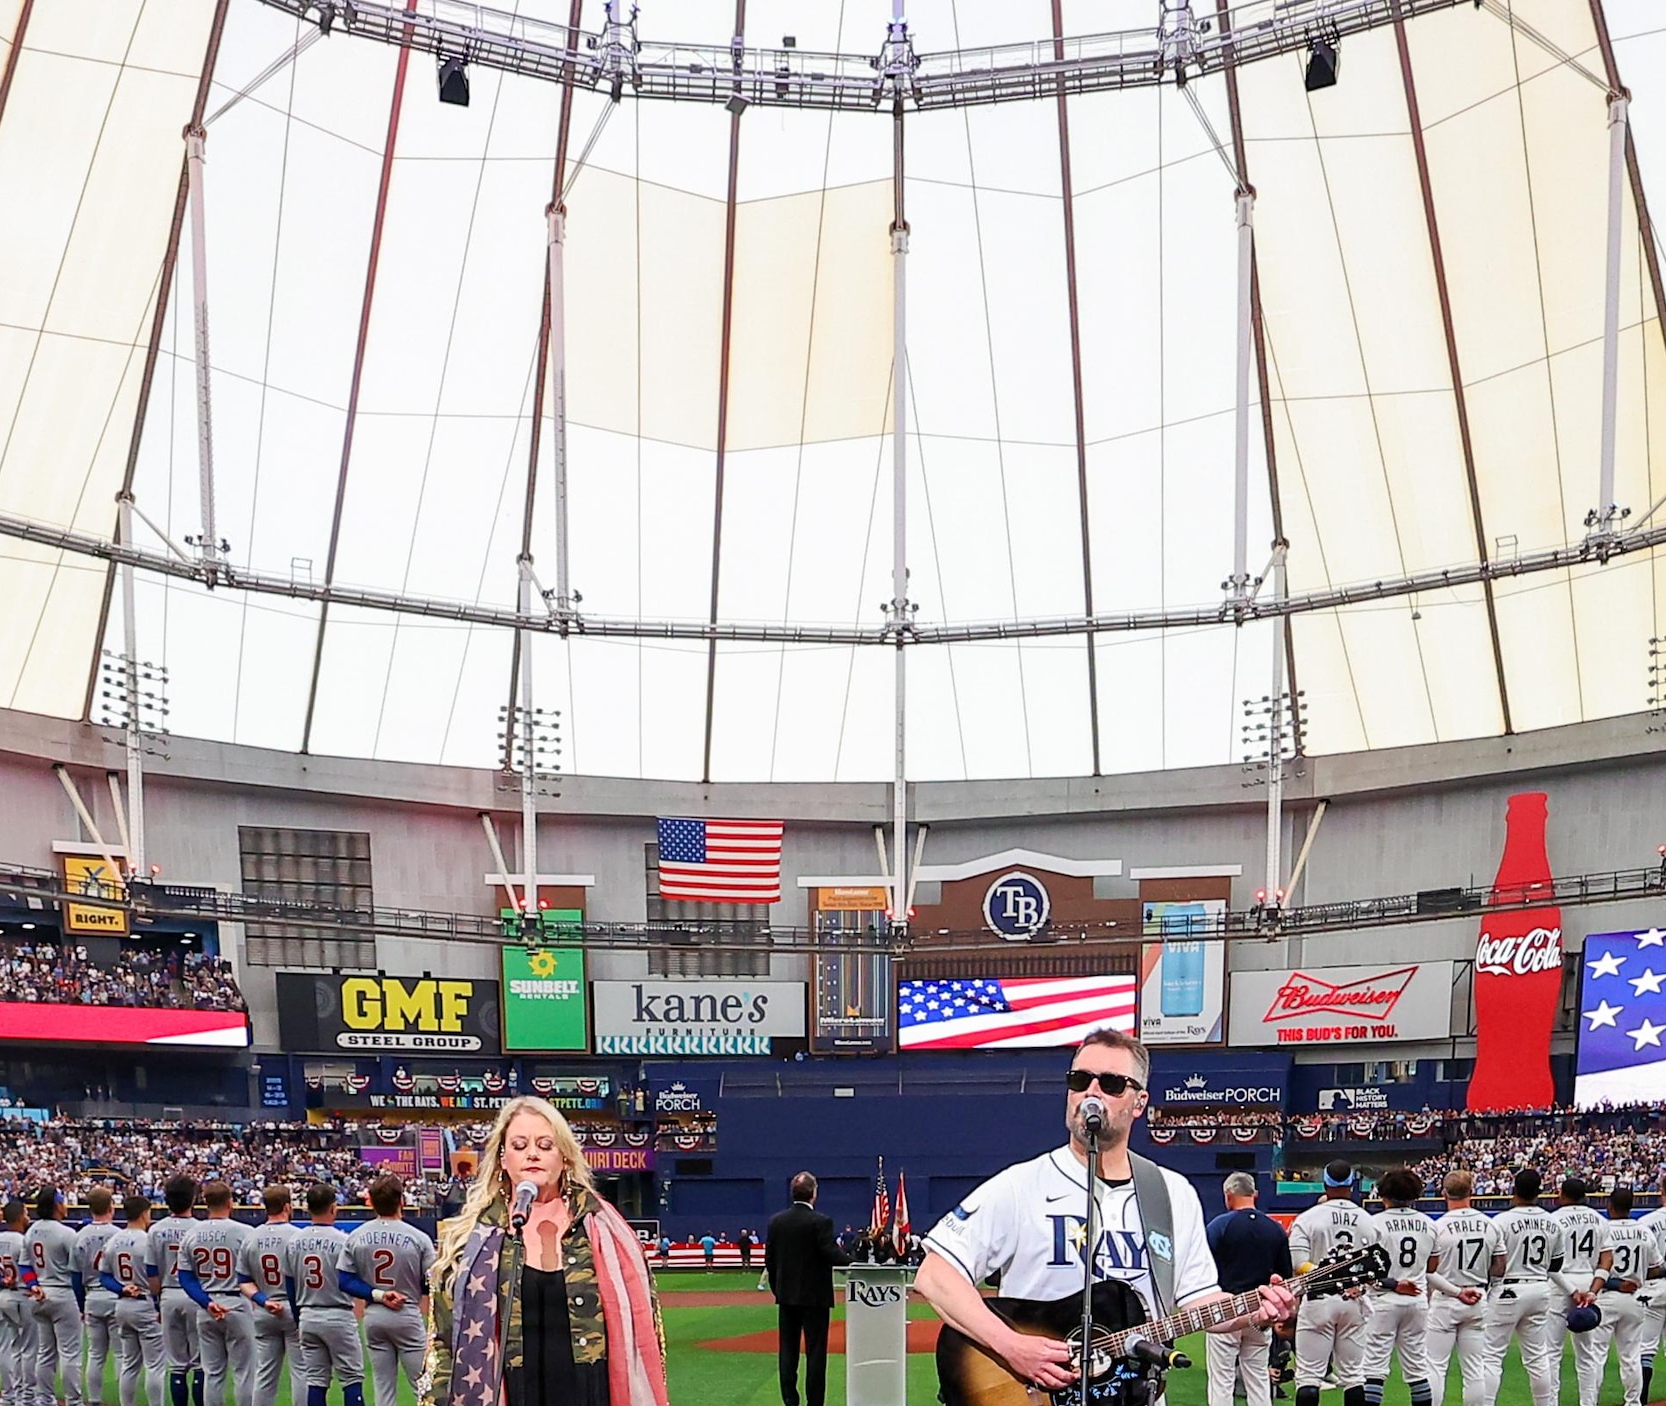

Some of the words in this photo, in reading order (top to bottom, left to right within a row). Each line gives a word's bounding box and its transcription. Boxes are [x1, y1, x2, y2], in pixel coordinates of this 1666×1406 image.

[75, 912, 119, 926] RIGHT.
[1475, 927, 1562, 976] Coca-Cola
[341, 977, 473, 1033] GMF
[519, 992, 569, 1001] RENTALS
[631, 983, 769, 1024] kane's
[1278, 985, 1402, 1011] Budweiser
[347, 1035, 406, 1047] STEEL
[412, 1036, 471, 1048] GROUP
[645, 1028, 756, 1037] FURNITURE
[1277, 1028, 1303, 1042] THIS
[1306, 1027, 1342, 1042] BUD'S
[1344, 1026, 1368, 1040] FOR
[1371, 1024, 1399, 1039] YOU.
[1165, 1089, 1224, 1101] Budweiser
[1225, 1087, 1281, 1103] PORCH
[1356, 1087, 1381, 1096] BLACK
[1356, 1094, 1388, 1102] HISTORY
[370, 1095, 386, 1107] WE
[395, 1096, 413, 1108] THE
[440, 1096, 454, 1108] WE
[655, 1099, 701, 1111] PORCH
[1355, 1101, 1388, 1110] MATTERS
[614, 1152, 646, 1169] DECK
[1331, 1211, 1359, 1227] DIAZ
[1385, 1219, 1429, 1234] ARANDA
[1447, 1221, 1488, 1235] FRALEY
[1559, 1214, 1601, 1230] SIMPSON
[197, 1230, 227, 1243] BUSCH
[258, 1237, 282, 1249] HAPP
[359, 1231, 412, 1249] HOERNER
[1570, 1229, 1595, 1259] 14
[33, 1242, 45, 1269] 9
[1045, 1213, 1150, 1282] RAY
[1399, 1236, 1417, 1268] 8
[1457, 1238, 1485, 1271] 17
[1521, 1235, 1547, 1266] 13
[117, 1253, 133, 1281] 6
[193, 1247, 231, 1279] 29
[373, 1249, 395, 1286] 2
[1613, 1245, 1641, 1273] 31
[260, 1254, 282, 1286] 8
[304, 1254, 323, 1289] 3
